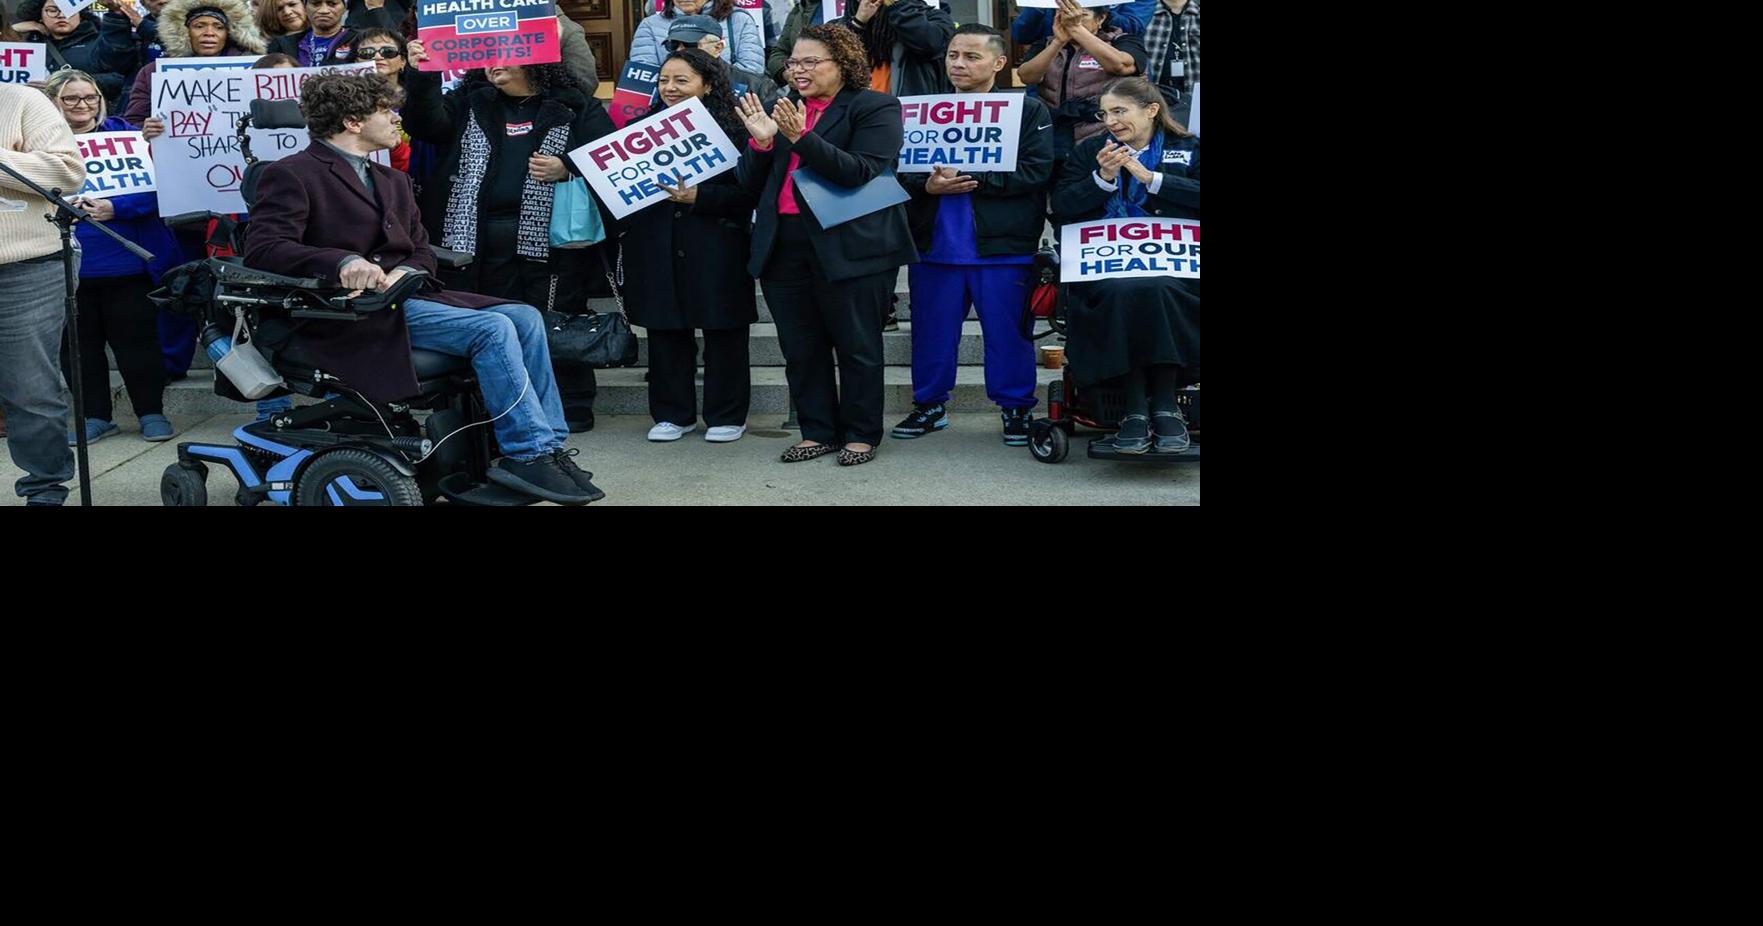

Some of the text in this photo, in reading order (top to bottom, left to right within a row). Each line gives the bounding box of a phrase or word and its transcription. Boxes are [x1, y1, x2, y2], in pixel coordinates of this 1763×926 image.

[423, 0, 494, 15] HEALTH
[463, 16, 511, 30] OVER
[431, 32, 545, 51] CORPORATE
[447, 46, 531, 63] PROFITS!
[158, 78, 242, 109] MAKE
[902, 101, 1009, 125] FIGHT
[588, 108, 696, 171] FIGHT
[943, 127, 1003, 143] OUR
[187, 132, 297, 159] SHAR TO
[607, 132, 712, 187] FOR OUR
[899, 146, 1003, 165] HEALTH
[85, 157, 145, 174] OUR
[618, 147, 727, 206] HEALTH
[1080, 222, 1200, 244] FIGHT
[1081, 244, 1134, 259] FOR
